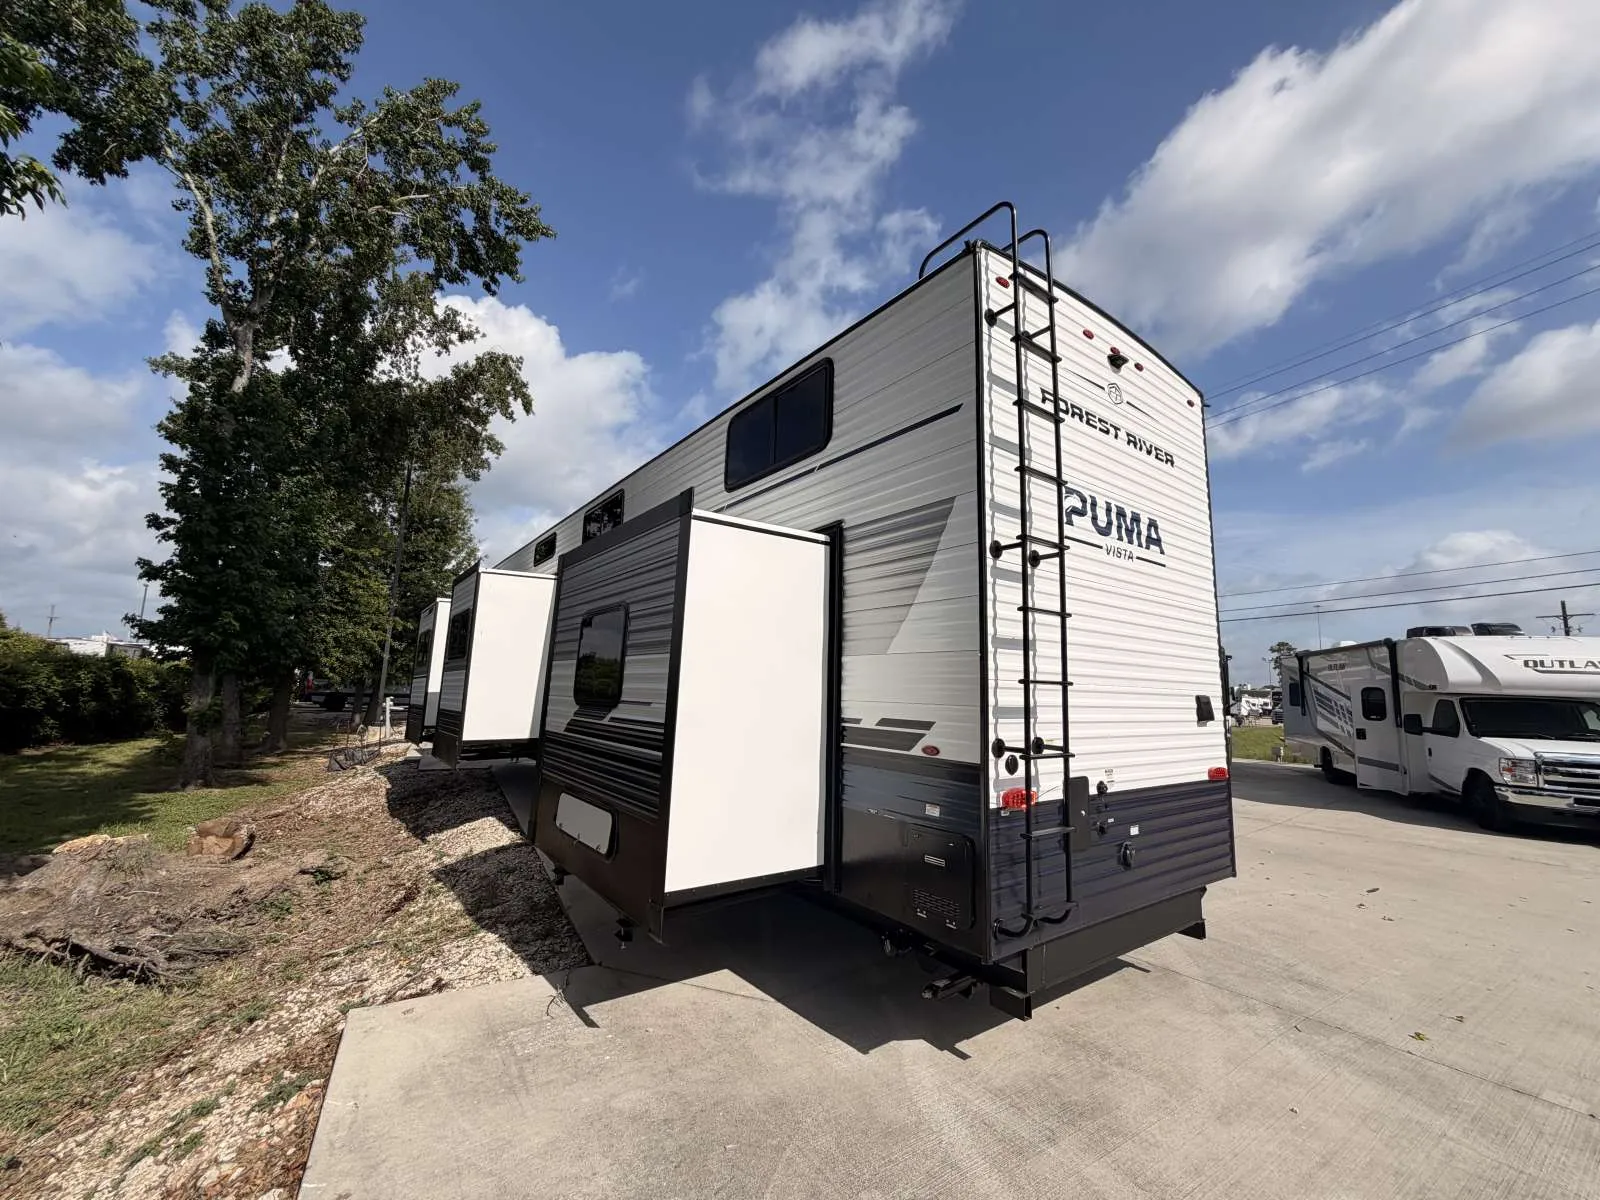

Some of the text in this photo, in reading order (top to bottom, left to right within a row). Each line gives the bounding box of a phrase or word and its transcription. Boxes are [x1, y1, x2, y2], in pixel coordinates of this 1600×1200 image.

[1040, 387, 1176, 468] FOREST RIVER
[1063, 485, 1166, 555] PUMA
[1105, 543, 1135, 562] VISTA
[1523, 659, 1600, 669] OUTLA
